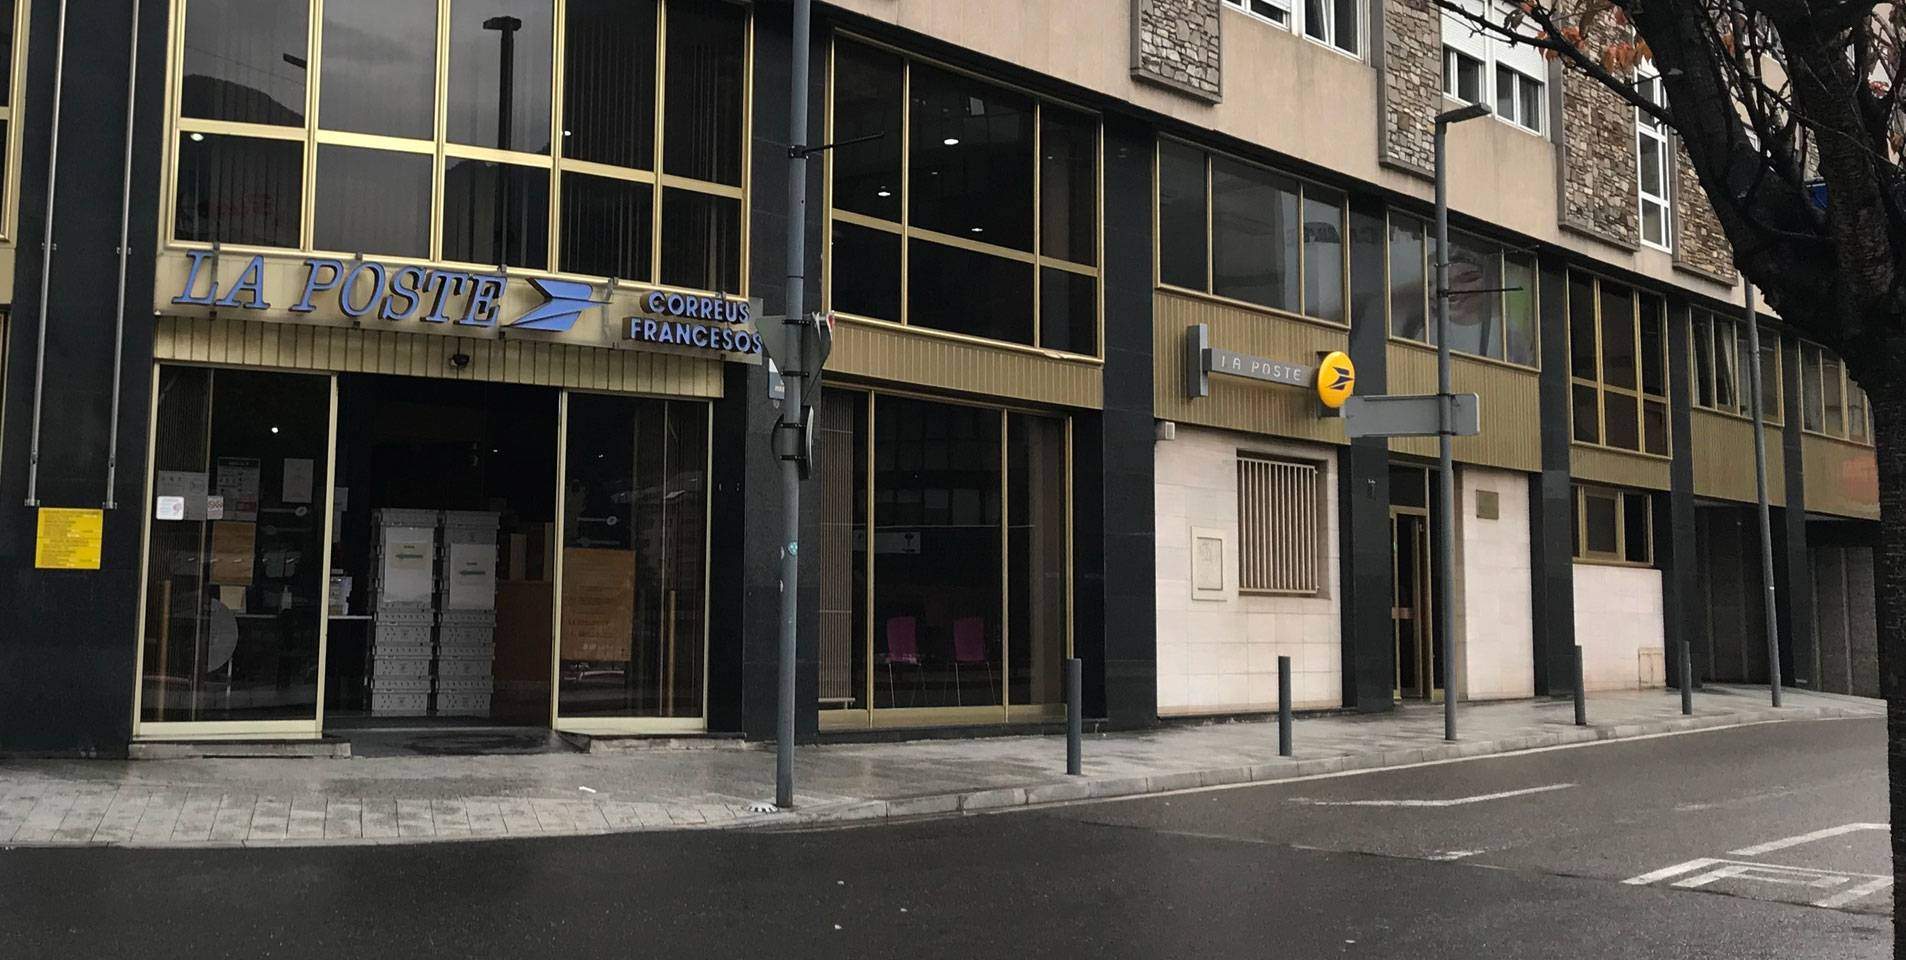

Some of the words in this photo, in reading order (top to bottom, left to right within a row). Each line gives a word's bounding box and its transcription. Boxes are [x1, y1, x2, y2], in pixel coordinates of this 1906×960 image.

[171, 249, 271, 311] LA
[288, 258, 508, 328] POSTE
[646, 289, 750, 324] CORREUS
[629, 317, 762, 354] FRANCESOS
[1251, 361, 1302, 381] POSTE
